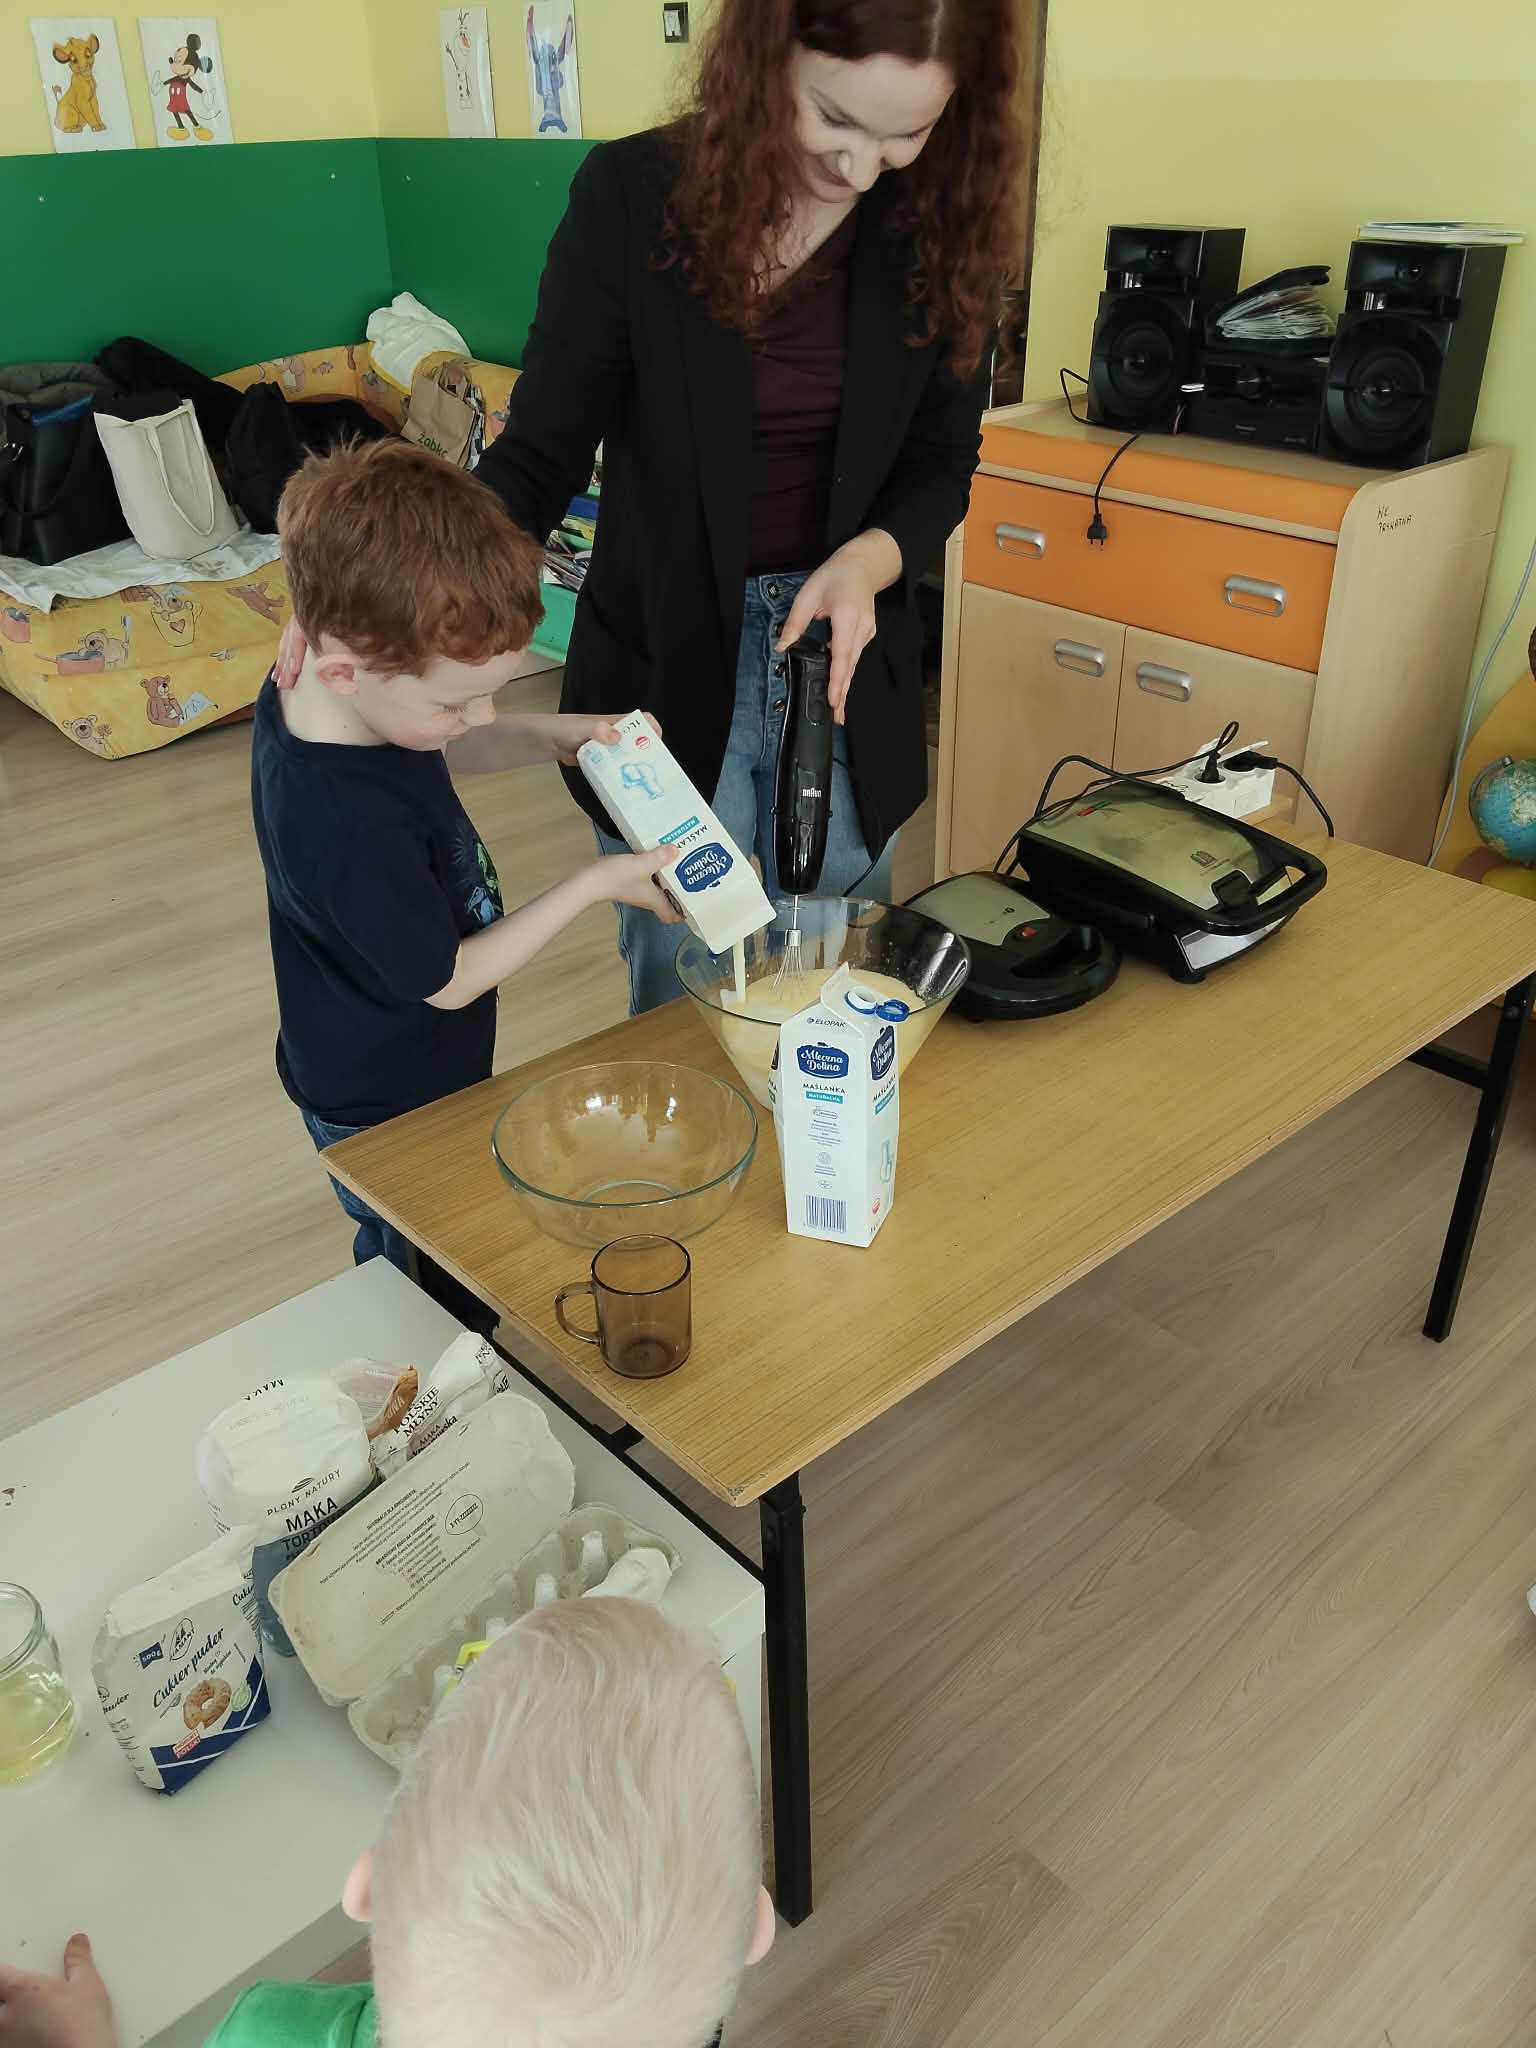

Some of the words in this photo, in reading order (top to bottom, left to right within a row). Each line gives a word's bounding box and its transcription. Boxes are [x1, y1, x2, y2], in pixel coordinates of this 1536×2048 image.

[677, 824, 709, 849] MAŚLAN
[685, 850, 719, 875] Dolina
[686, 856, 727, 885] Mleczna
[815, 1018, 847, 1028] ELOPAK
[800, 1049, 844, 1064] Mleczna
[806, 1060, 841, 1073] Dolina
[803, 1082, 846, 1094] MAŚLANKA
[266, 1496, 301, 1517] PLONY
[305, 1468, 342, 1497] NATURY
[153, 1663, 190, 1708] Cukier
[191, 1626, 225, 1673] puder
